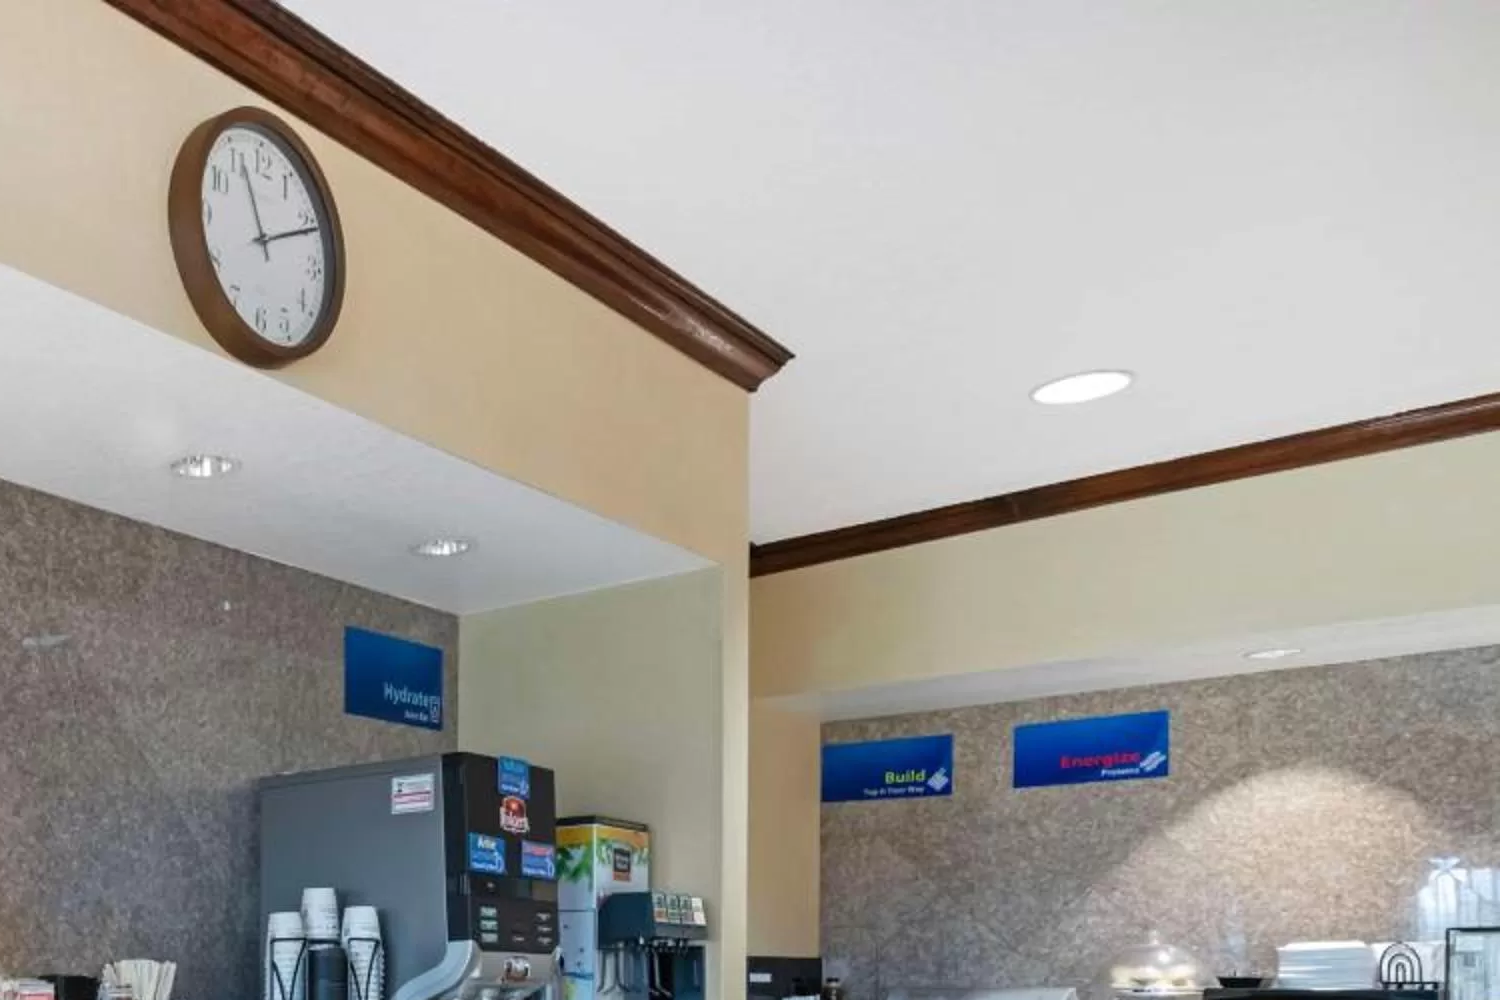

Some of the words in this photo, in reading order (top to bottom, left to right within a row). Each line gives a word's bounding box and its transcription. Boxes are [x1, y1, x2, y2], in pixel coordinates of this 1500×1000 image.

[255, 148, 273, 181] 12
[211, 164, 229, 195] 10
[1060, 751, 1141, 769] Energize
[885, 768, 927, 785] Build
